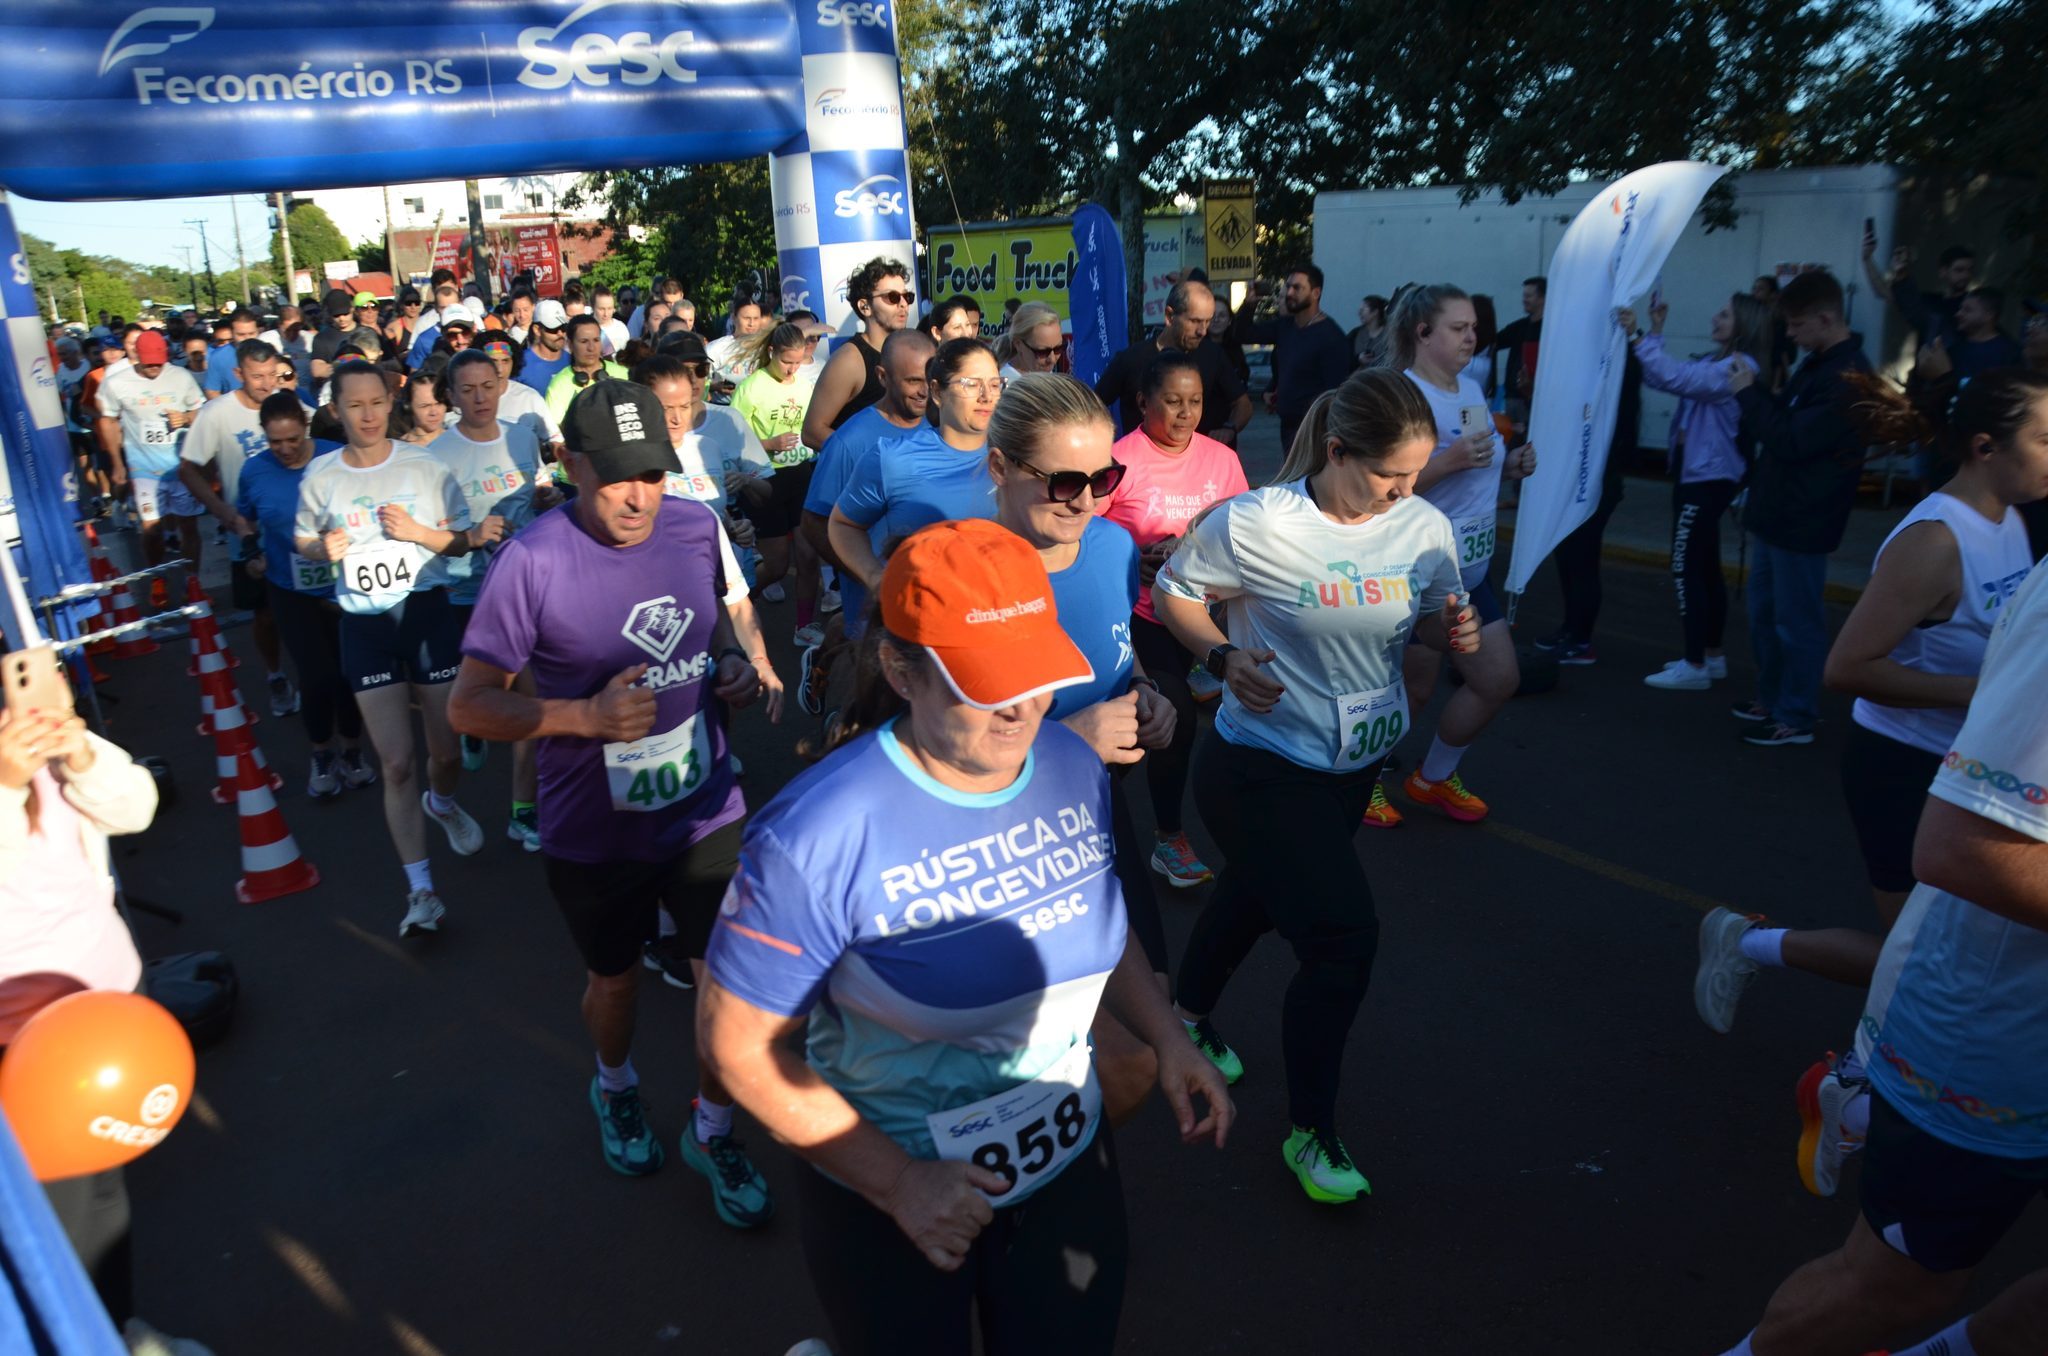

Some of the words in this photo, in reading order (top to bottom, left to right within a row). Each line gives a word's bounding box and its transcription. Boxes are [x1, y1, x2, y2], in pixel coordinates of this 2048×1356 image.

[816, 1, 887, 29] Sesc
[516, 25, 698, 90] Sesc
[134, 62, 395, 106] Fecomércio
[408, 59, 463, 95] RS
[834, 188, 904, 218] Sesc
[936, 242, 998, 294] Food
[1010, 239, 1080, 292] Truck
[1210, 255, 1252, 271] ELEVADA
[1096, 305, 1110, 358] Sindicatos
[618, 421, 643, 433] ECO
[779, 447, 808, 463] 399
[1165, 495, 1185, 506] MAIS
[1186, 495, 1201, 506] QUE
[1463, 528, 1495, 563] 359
[1672, 503, 1700, 574] GROWTH
[356, 557, 412, 593] 604
[1297, 574, 1422, 609] Autismo
[361, 671, 392, 686] RUN
[1348, 710, 1404, 762] 309
[626, 749, 701, 807] 403
[880, 816, 1060, 903] RÚSTICA
[1058, 802, 1097, 838] DA
[1018, 892, 1089, 940] sesc
[972, 1091, 1087, 1198] 858
